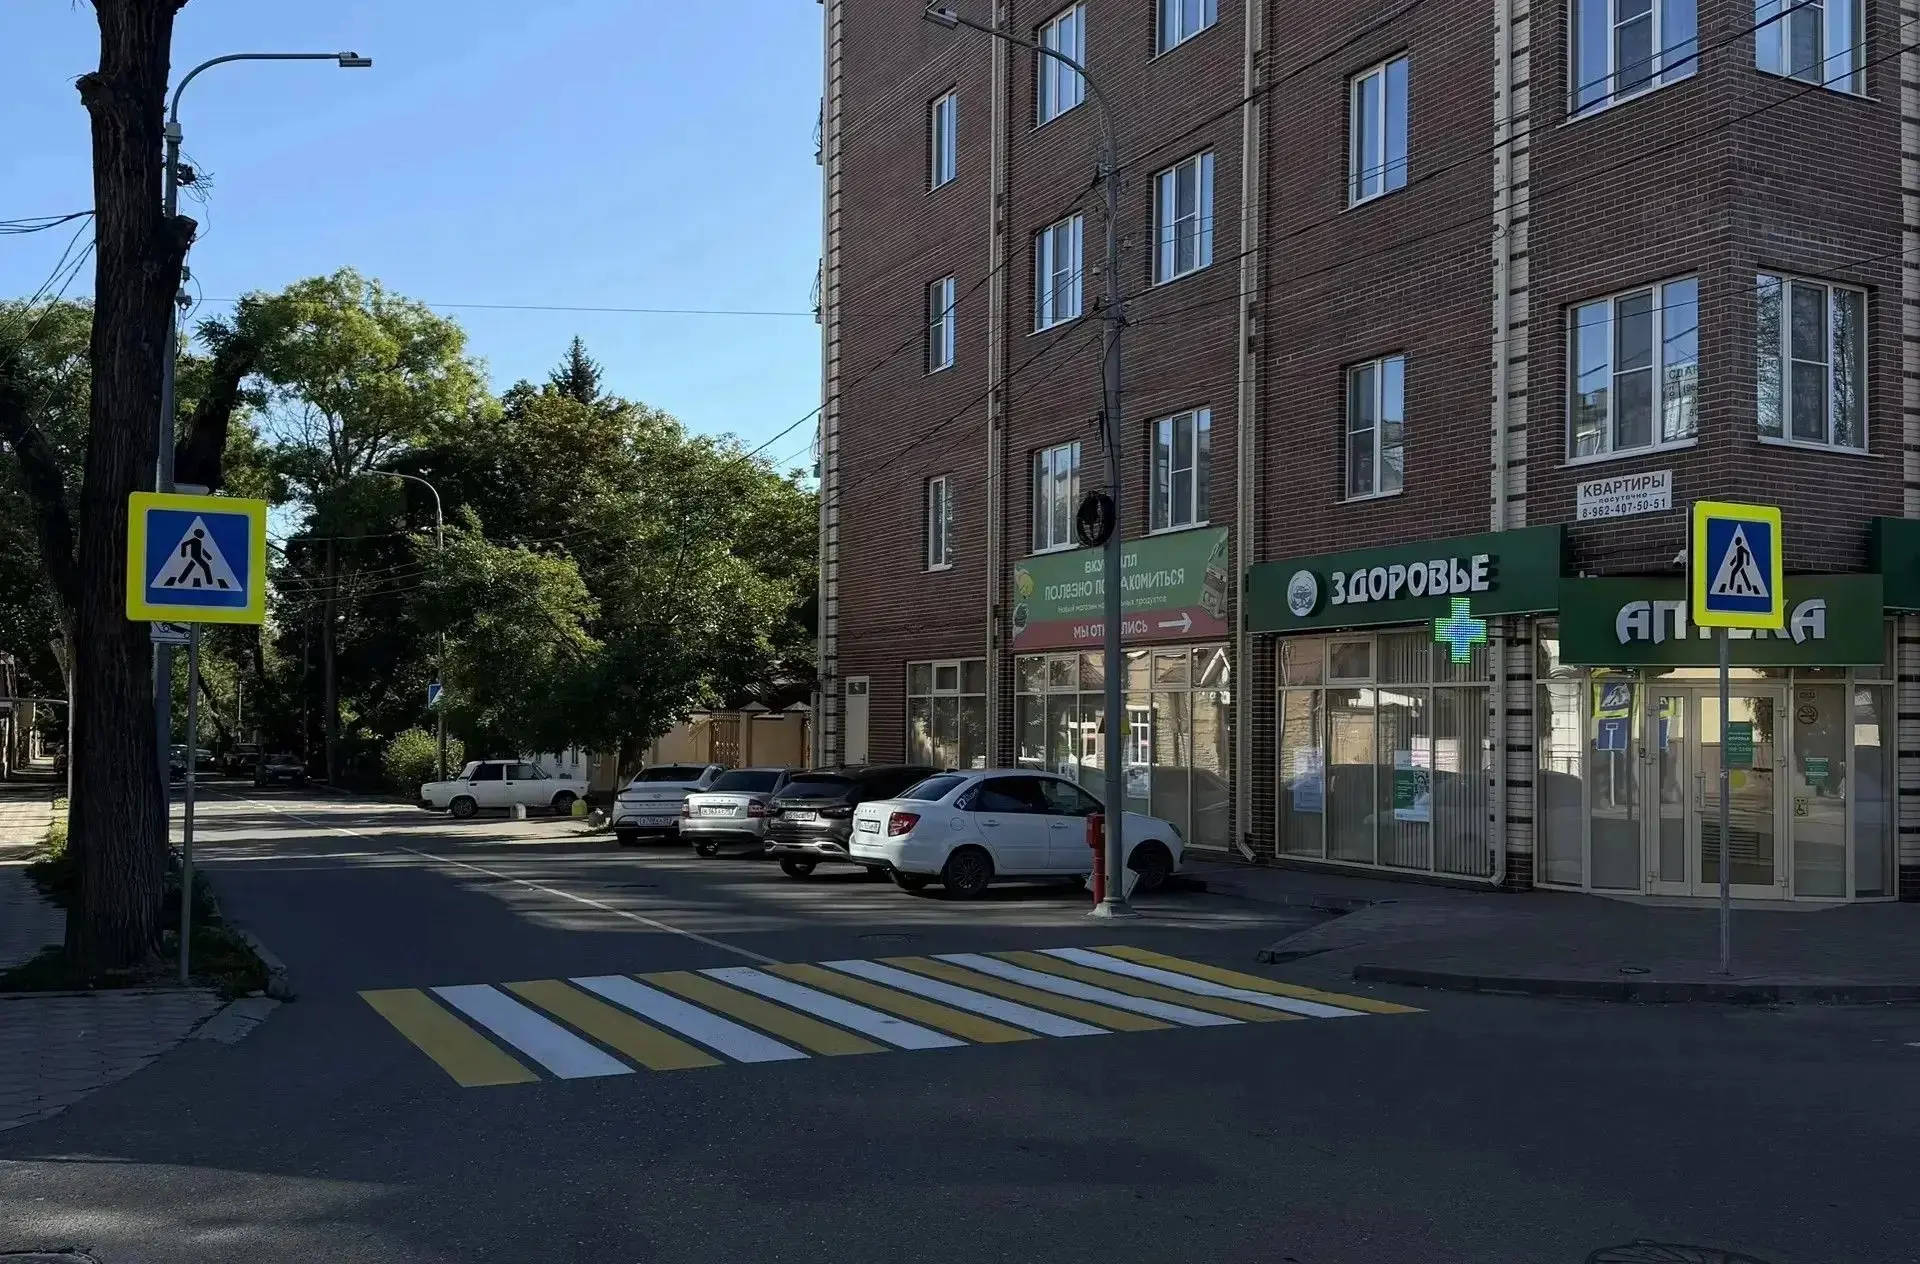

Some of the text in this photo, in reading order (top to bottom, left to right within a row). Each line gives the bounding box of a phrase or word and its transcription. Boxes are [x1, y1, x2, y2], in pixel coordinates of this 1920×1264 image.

[1583, 474, 1665, 498] КВАРТИРЫ
[1582, 498, 1666, 518] 8-962-407-50-51
[1599, 492, 1648, 504] посуточно
[1095, 568, 1185, 595] ПОАКОМИТЬСЯ
[1331, 553, 1490, 605] ЗДОРОВЬЕ
[1073, 620, 1149, 639] МЫ ОТЛИСЬ
